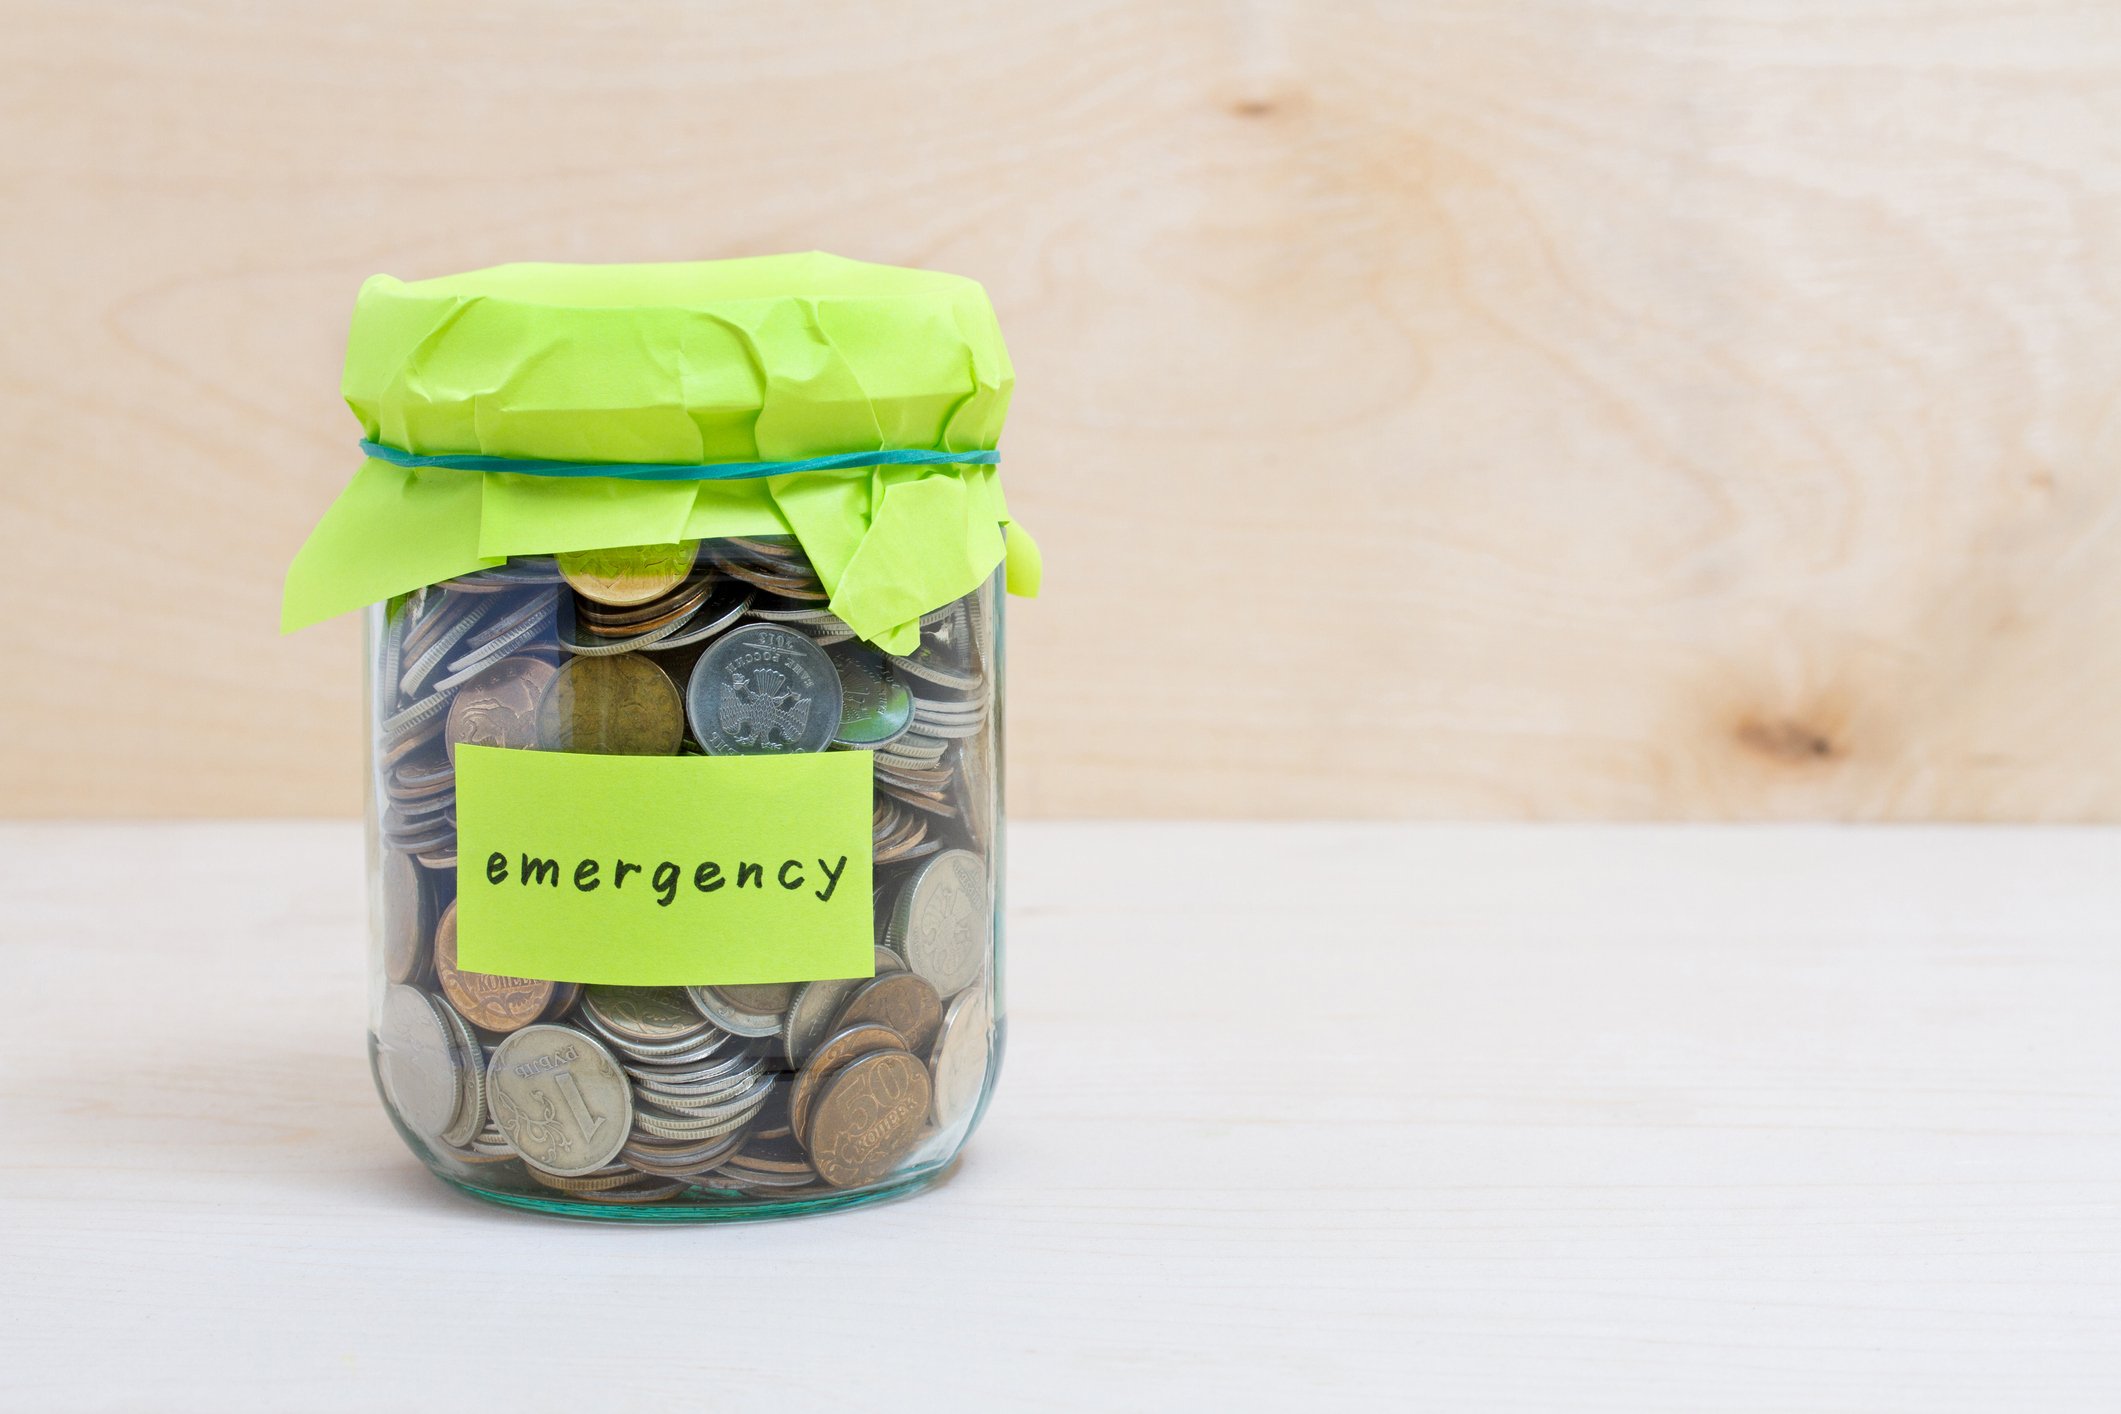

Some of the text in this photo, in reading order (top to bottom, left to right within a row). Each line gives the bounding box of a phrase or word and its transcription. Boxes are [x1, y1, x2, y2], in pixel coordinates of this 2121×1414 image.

[724, 651, 815, 688] БАНК РОССИИ
[485, 850, 849, 908] emergency
[514, 1045, 580, 1079] РУБЛЬ
[555, 1071, 606, 1144] 1
[836, 1057, 910, 1137] 50
[856, 1096, 919, 1154] КОПЕЕК
